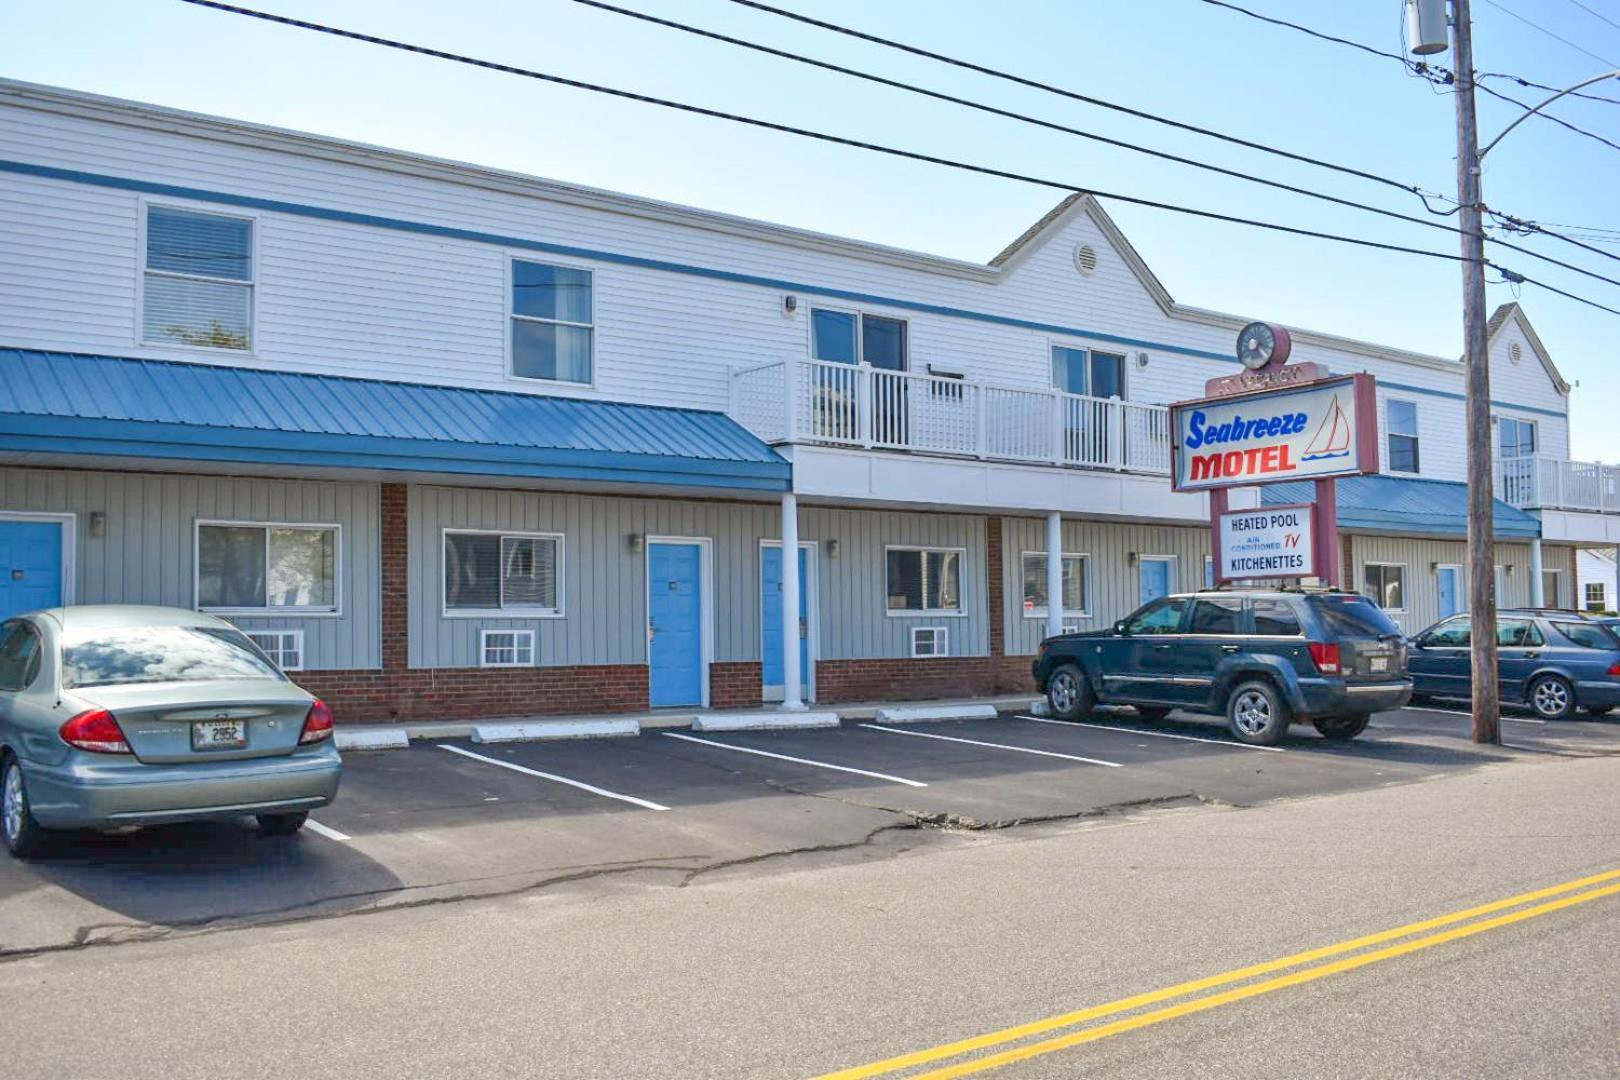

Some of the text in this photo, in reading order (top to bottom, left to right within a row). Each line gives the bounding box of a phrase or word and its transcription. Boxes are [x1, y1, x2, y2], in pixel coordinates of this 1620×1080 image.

[1185, 410, 1308, 449] Seabreeze
[1190, 444, 1297, 481] MOTEL
[1231, 513, 1299, 532] HEATED POOL
[1231, 542, 1281, 552] CONDITIONED
[1284, 533, 1301, 548] TV
[1231, 554, 1304, 571] KITCHENETTES
